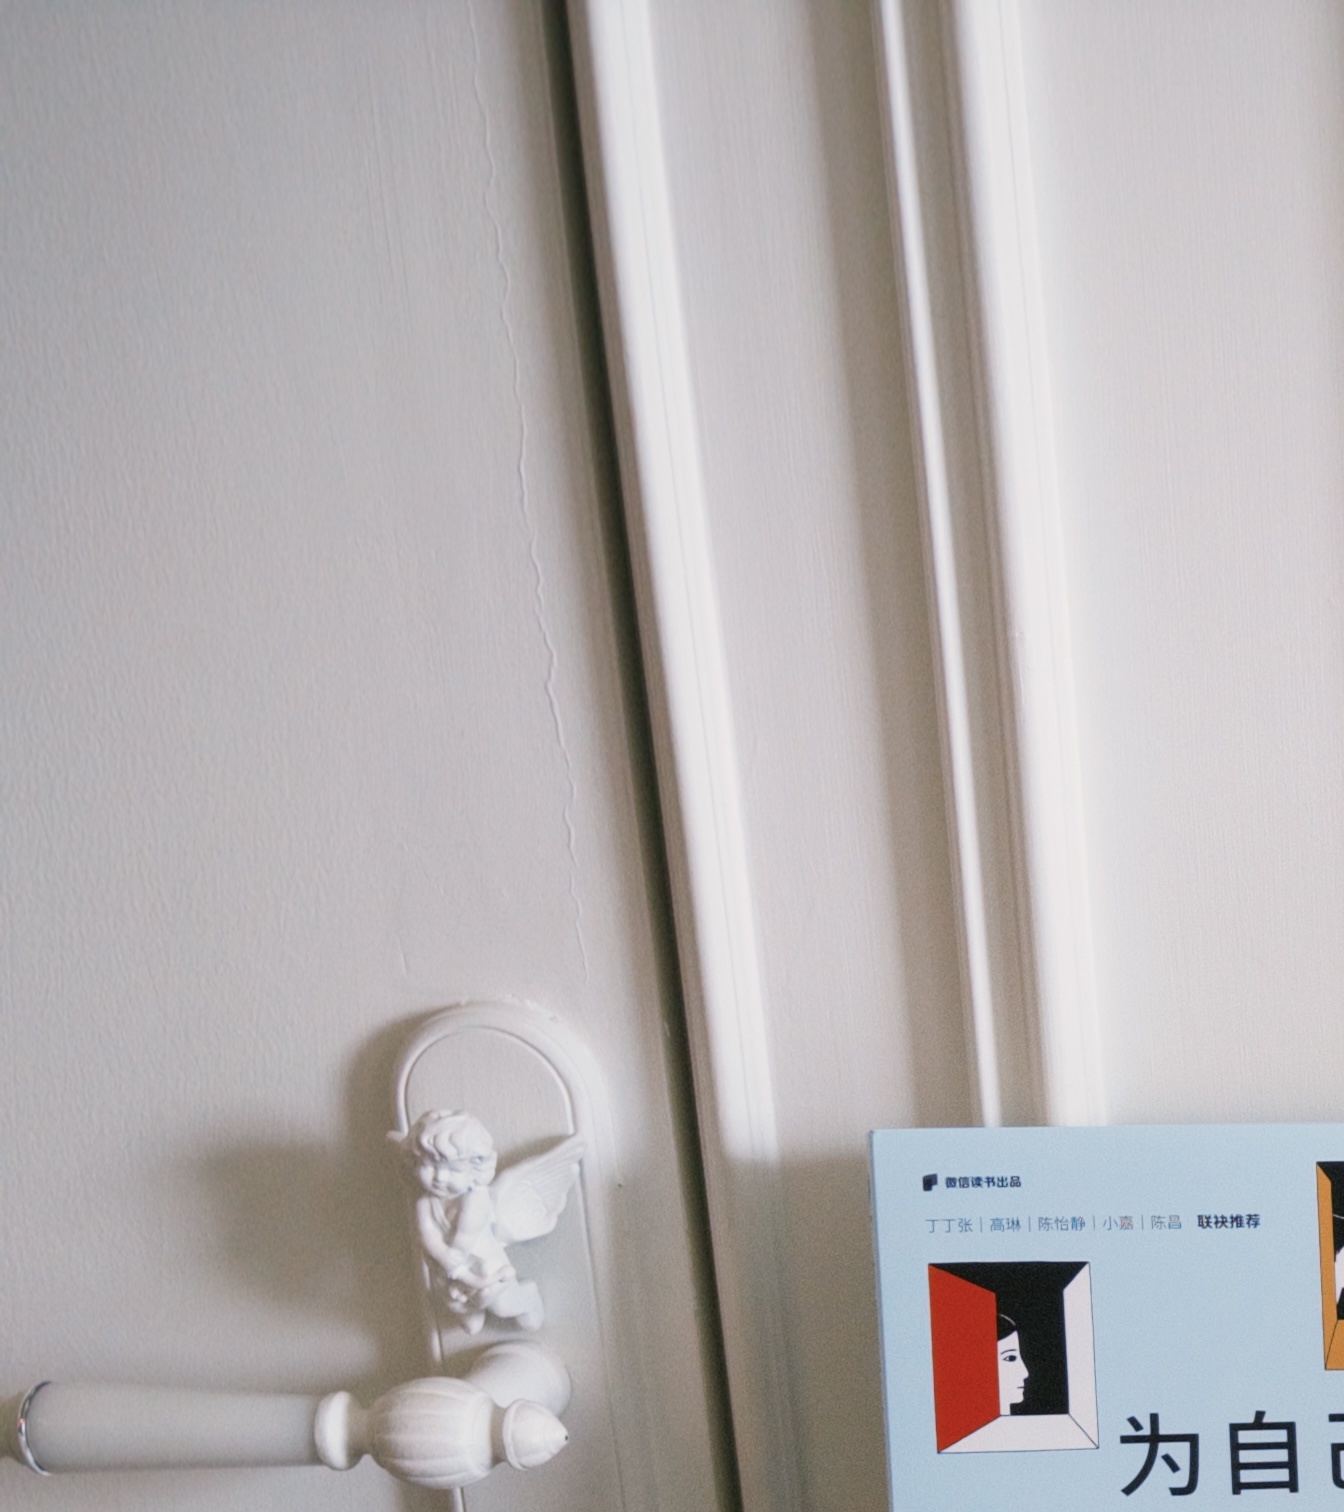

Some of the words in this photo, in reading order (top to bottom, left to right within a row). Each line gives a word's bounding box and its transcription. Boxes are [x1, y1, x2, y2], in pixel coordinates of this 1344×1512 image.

[945, 1175, 1022, 1189] 微信读书出品
[1197, 1213, 1262, 1230] 联袂推荐
